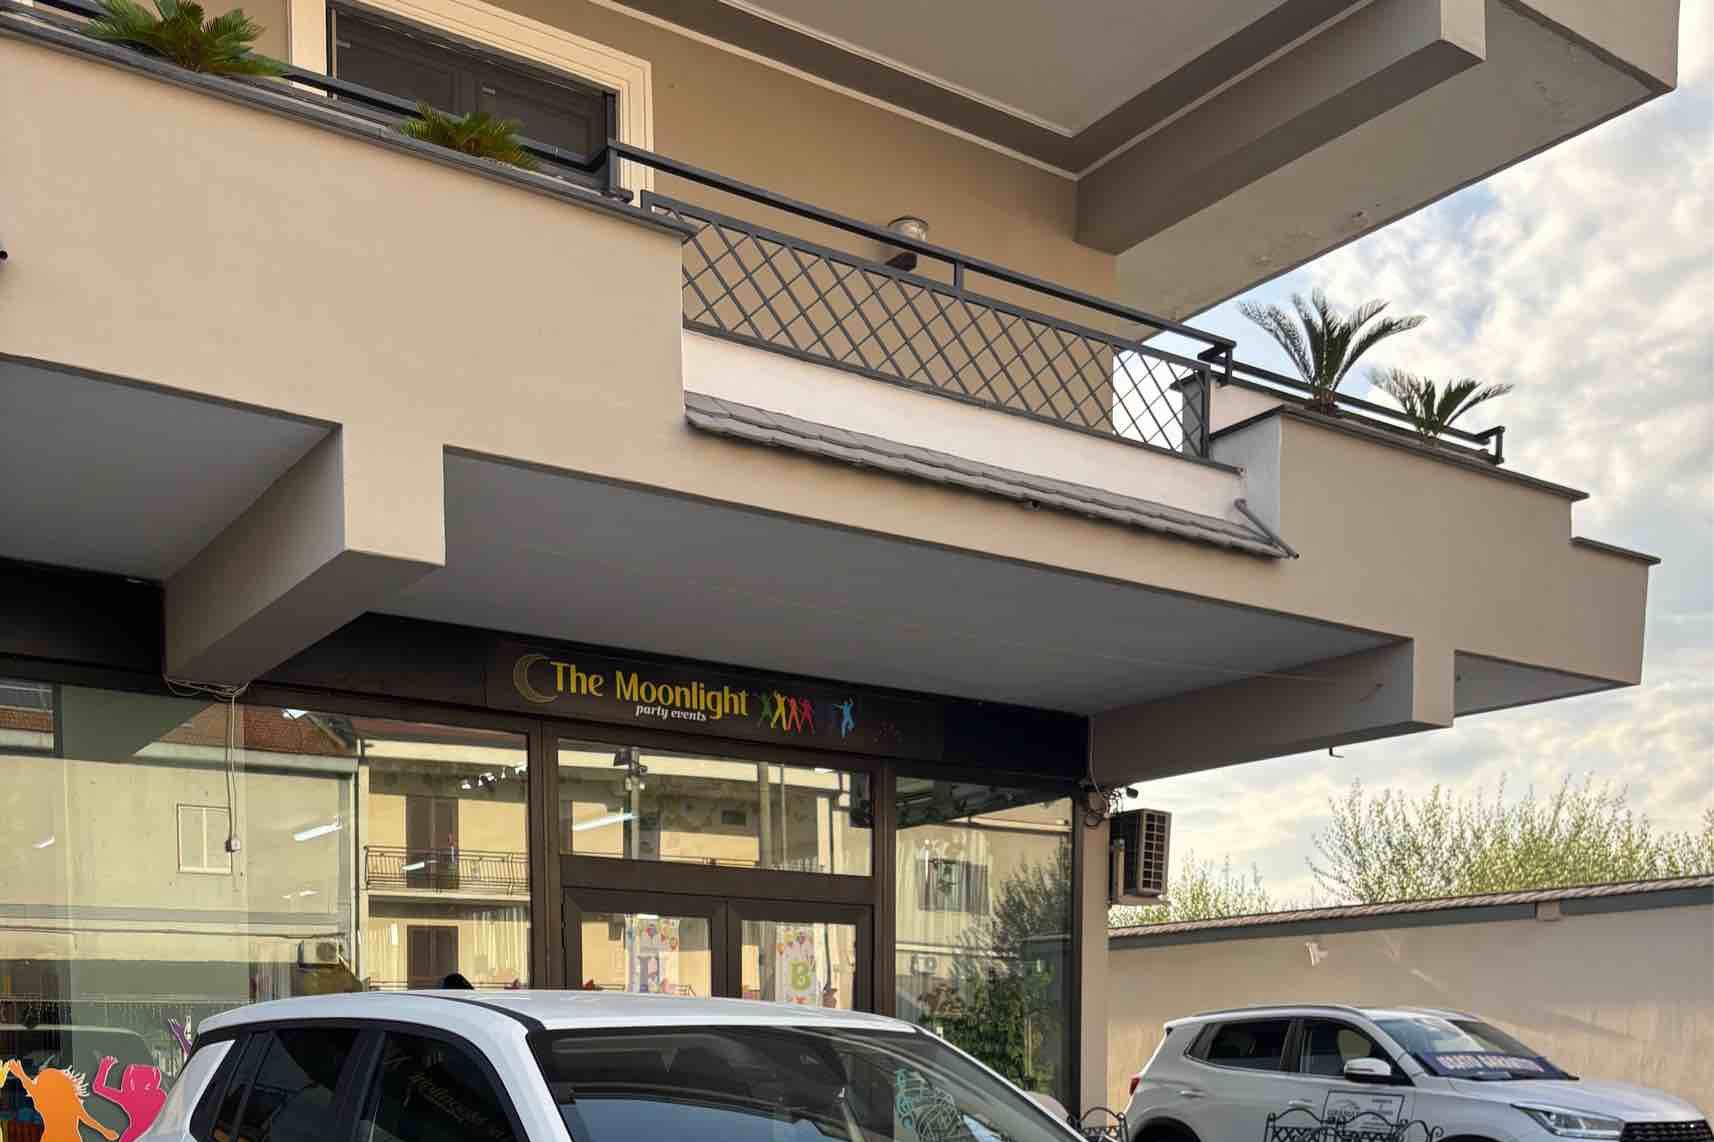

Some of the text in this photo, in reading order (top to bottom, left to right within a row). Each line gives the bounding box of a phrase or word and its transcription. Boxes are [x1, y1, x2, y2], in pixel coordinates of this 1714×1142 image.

[549, 661, 748, 720] The Moonlight
[635, 704, 707, 721] party events
